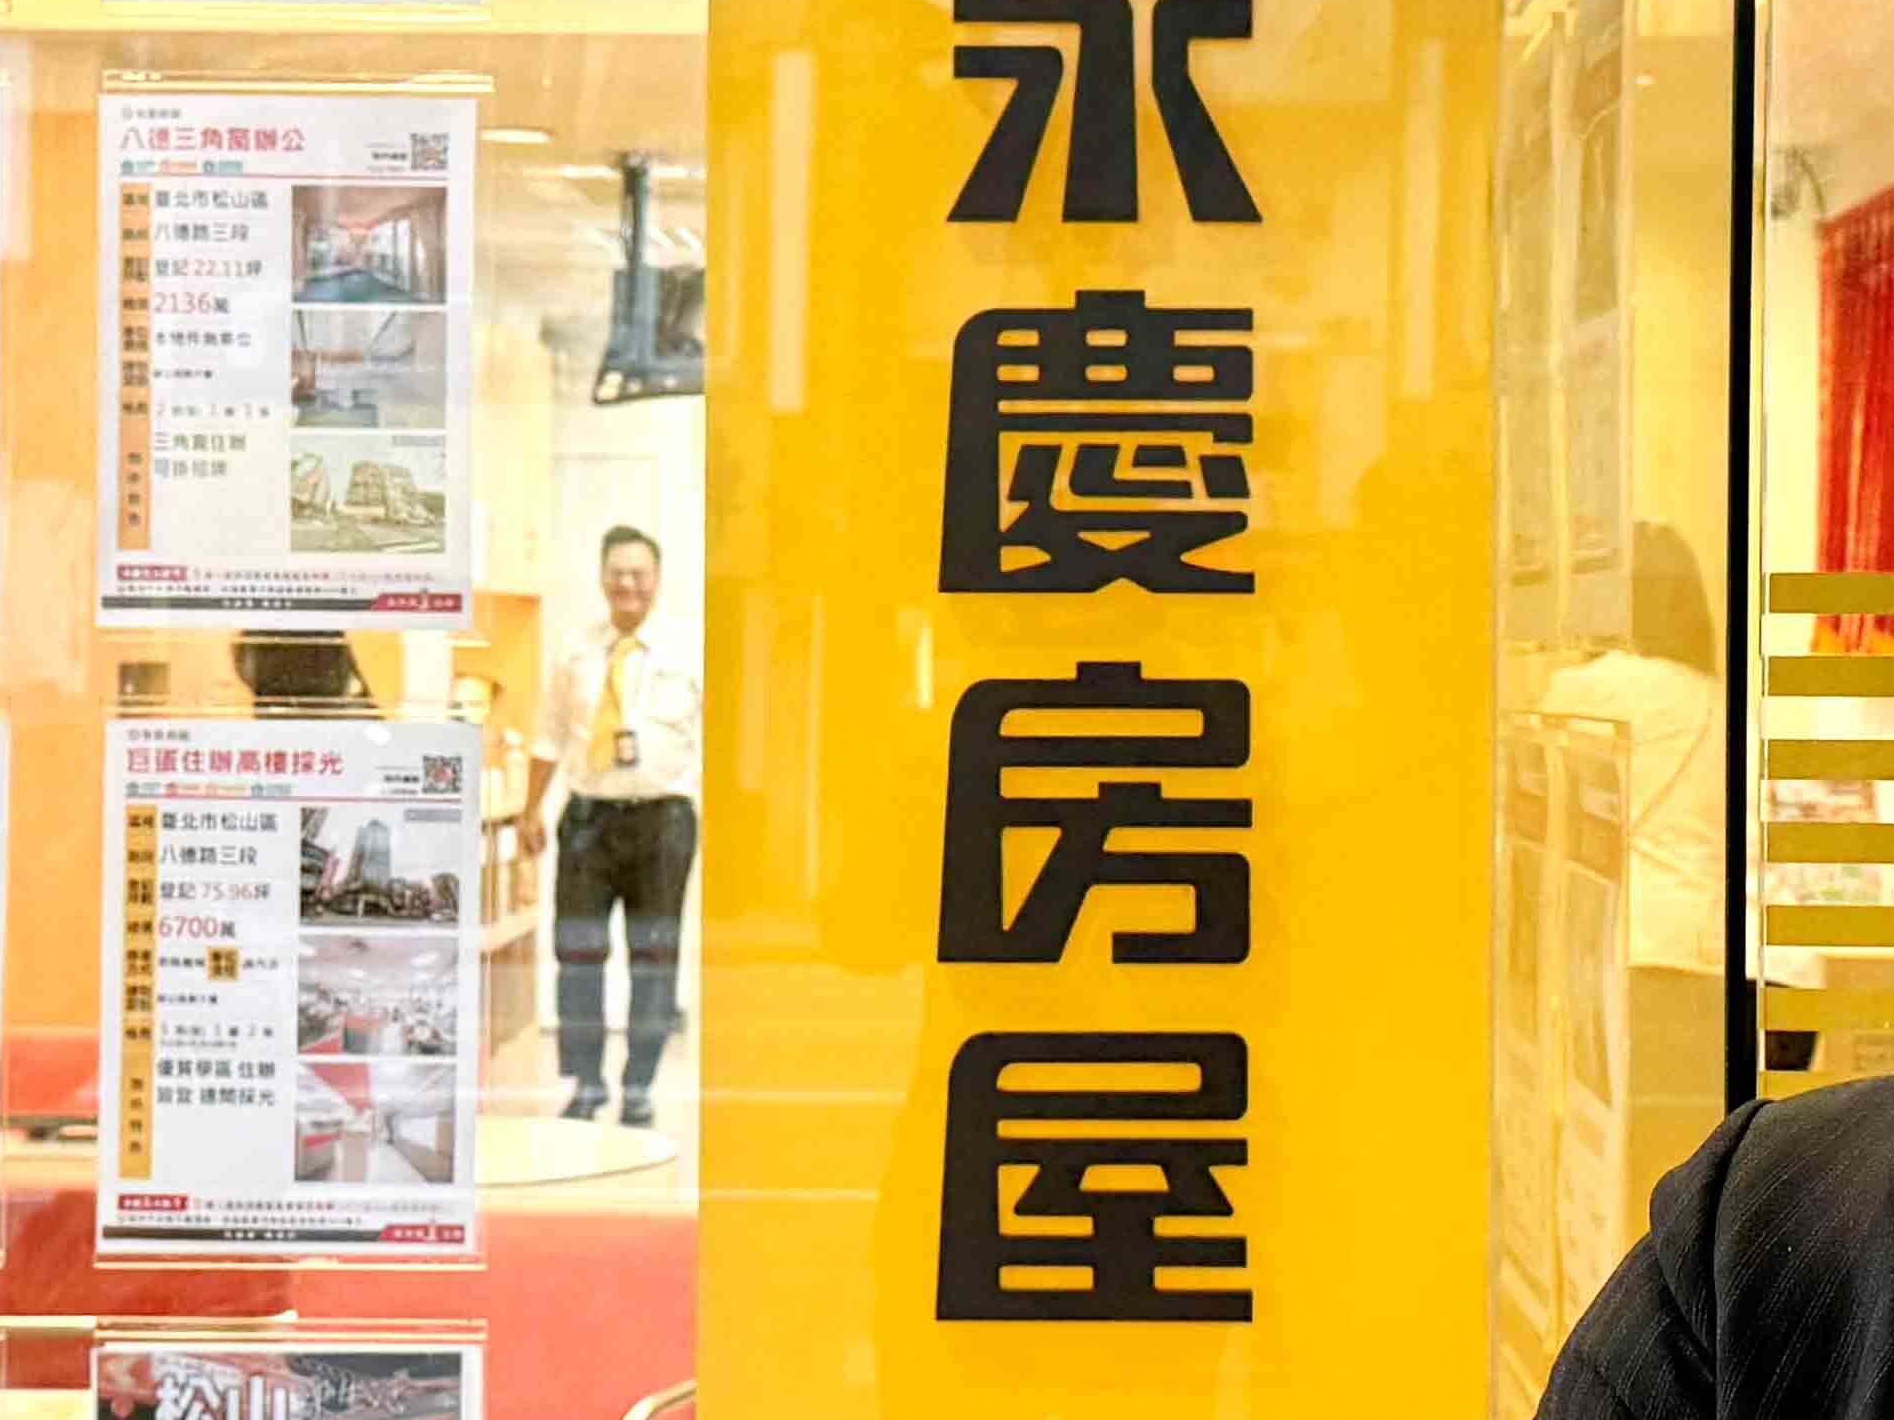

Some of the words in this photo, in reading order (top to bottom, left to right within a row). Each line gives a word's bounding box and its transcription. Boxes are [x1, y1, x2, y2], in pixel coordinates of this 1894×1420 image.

[153, 292, 230, 314] 2136萬
[127, 748, 345, 775] 巨蛋住辦高樓採光
[161, 846, 258, 865] 八德路三段
[159, 916, 236, 938] 6700萬
